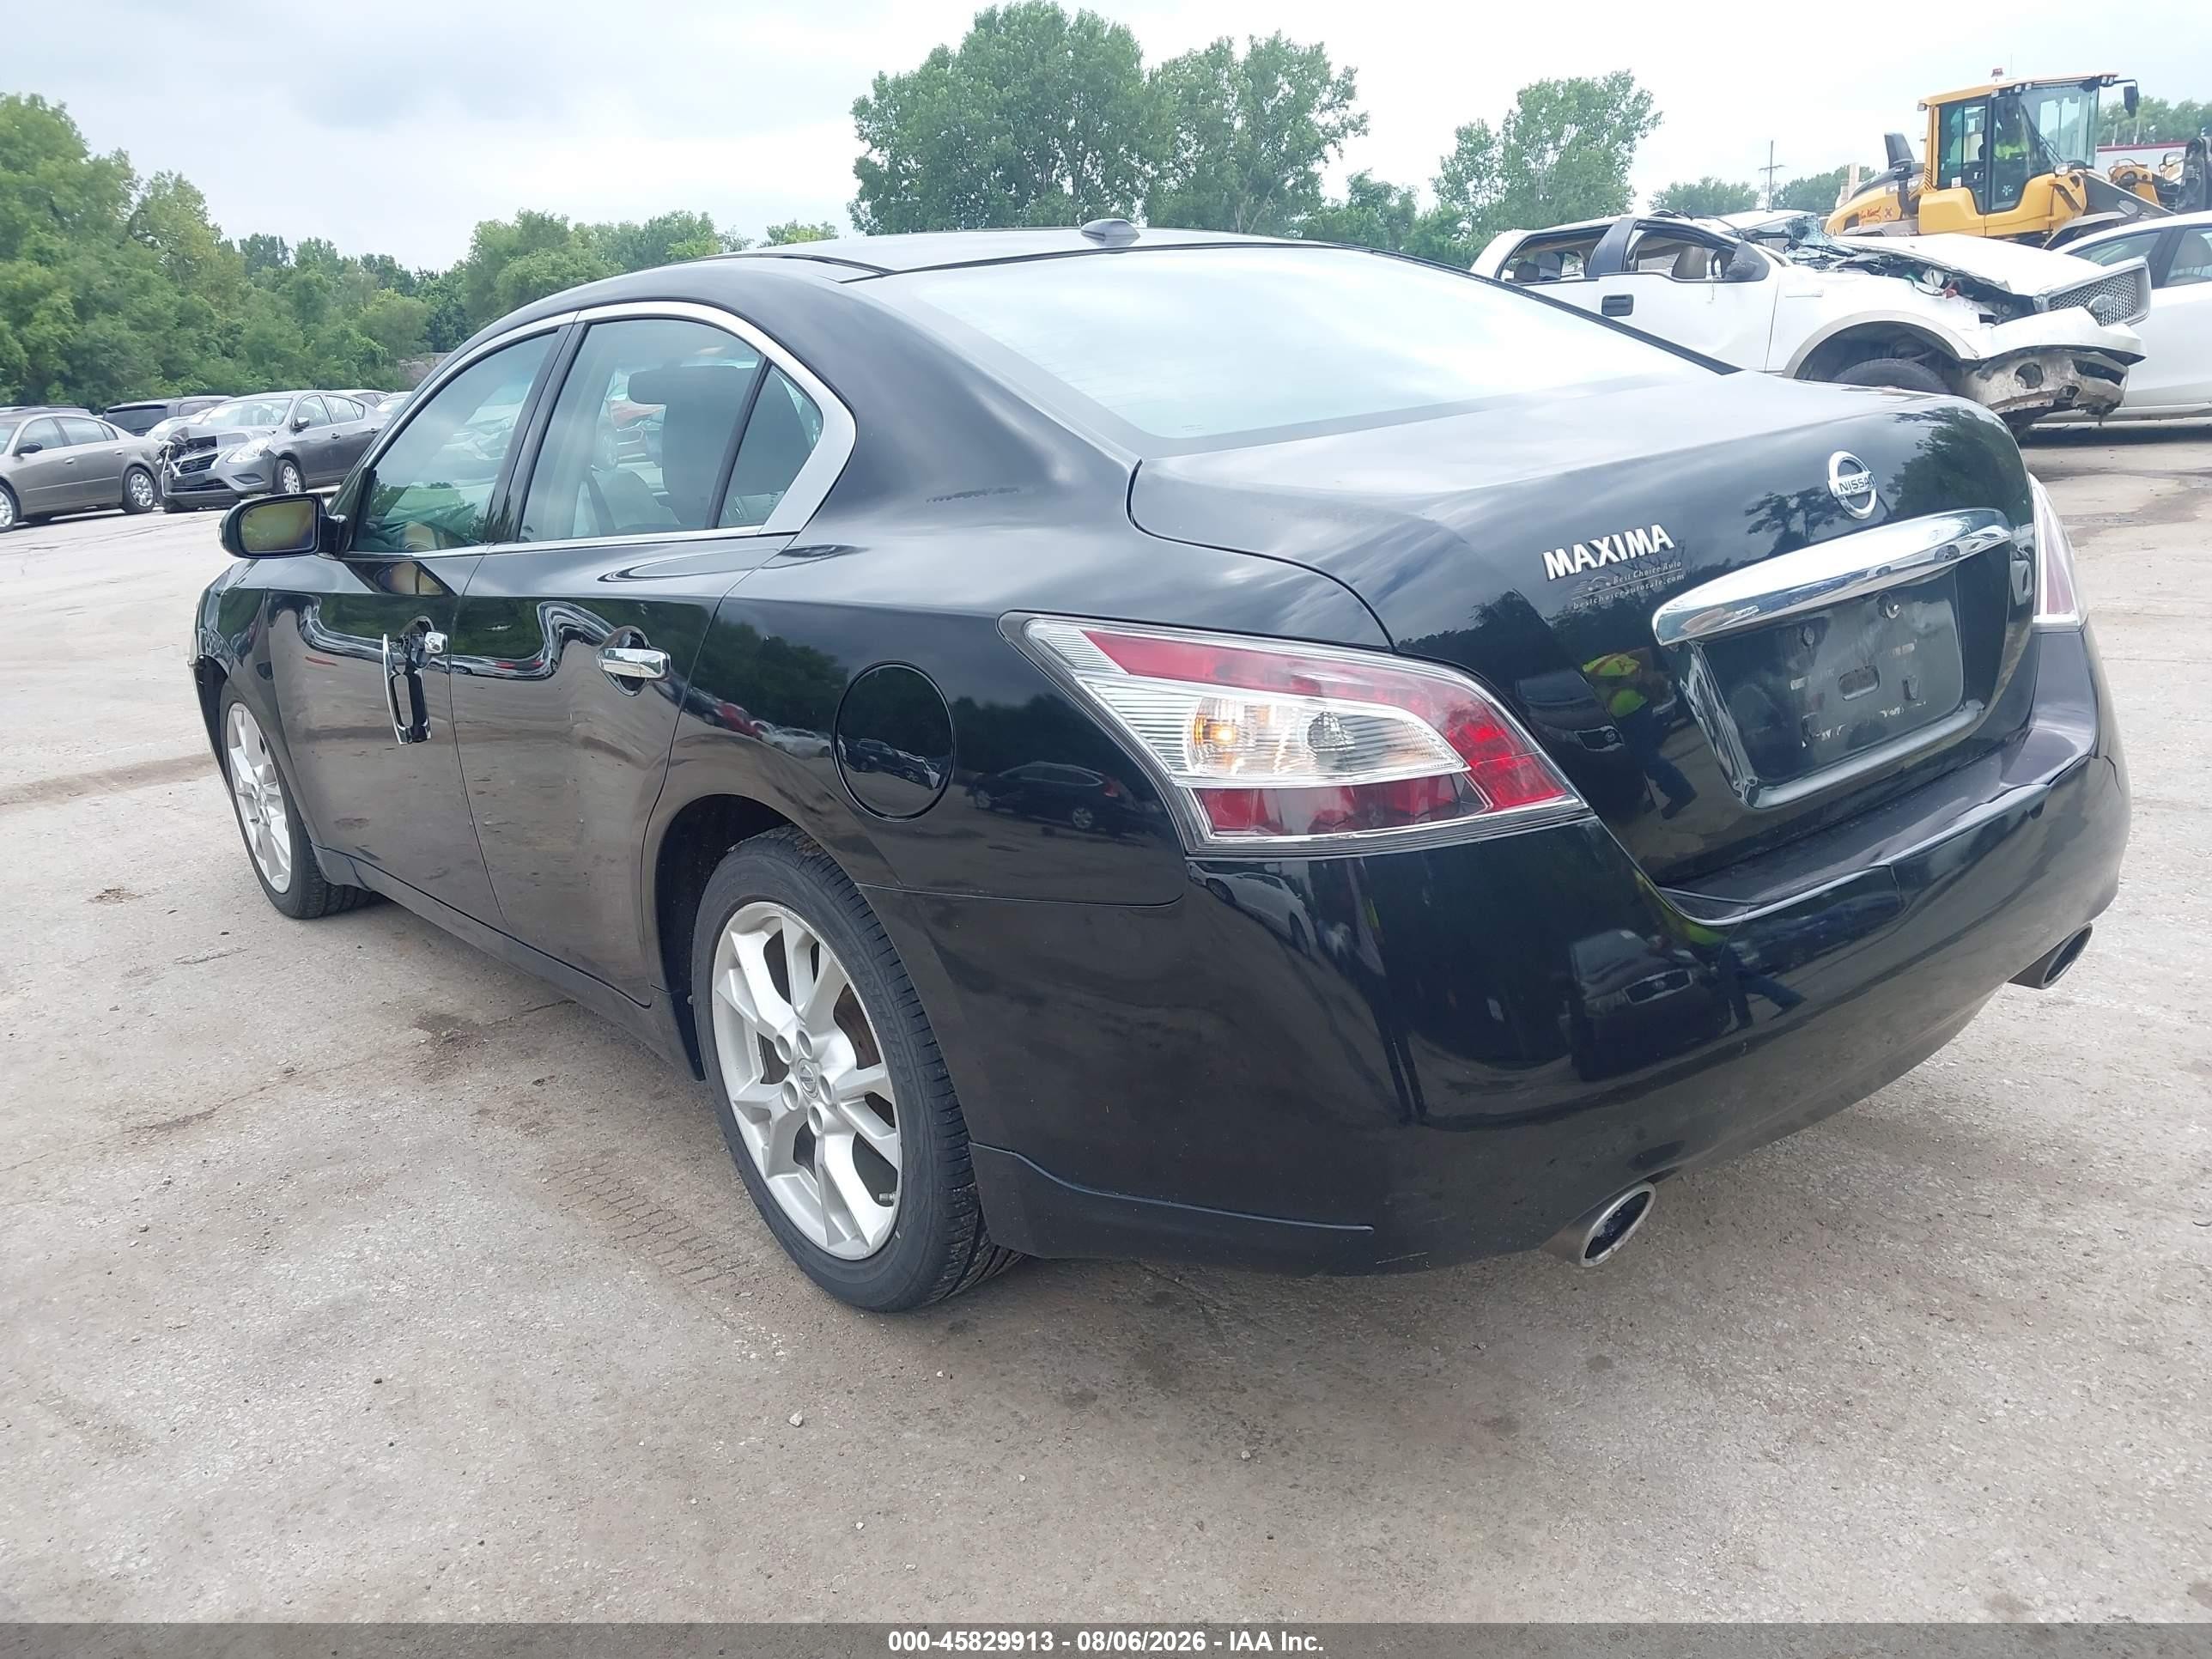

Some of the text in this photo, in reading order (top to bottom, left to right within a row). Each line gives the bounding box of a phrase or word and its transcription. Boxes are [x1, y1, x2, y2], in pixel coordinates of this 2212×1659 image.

[1838, 473, 1875, 492] NISSAN
[1542, 524, 1675, 580] MAXIMA
[1613, 561, 1682, 585] Best Choice Auto
